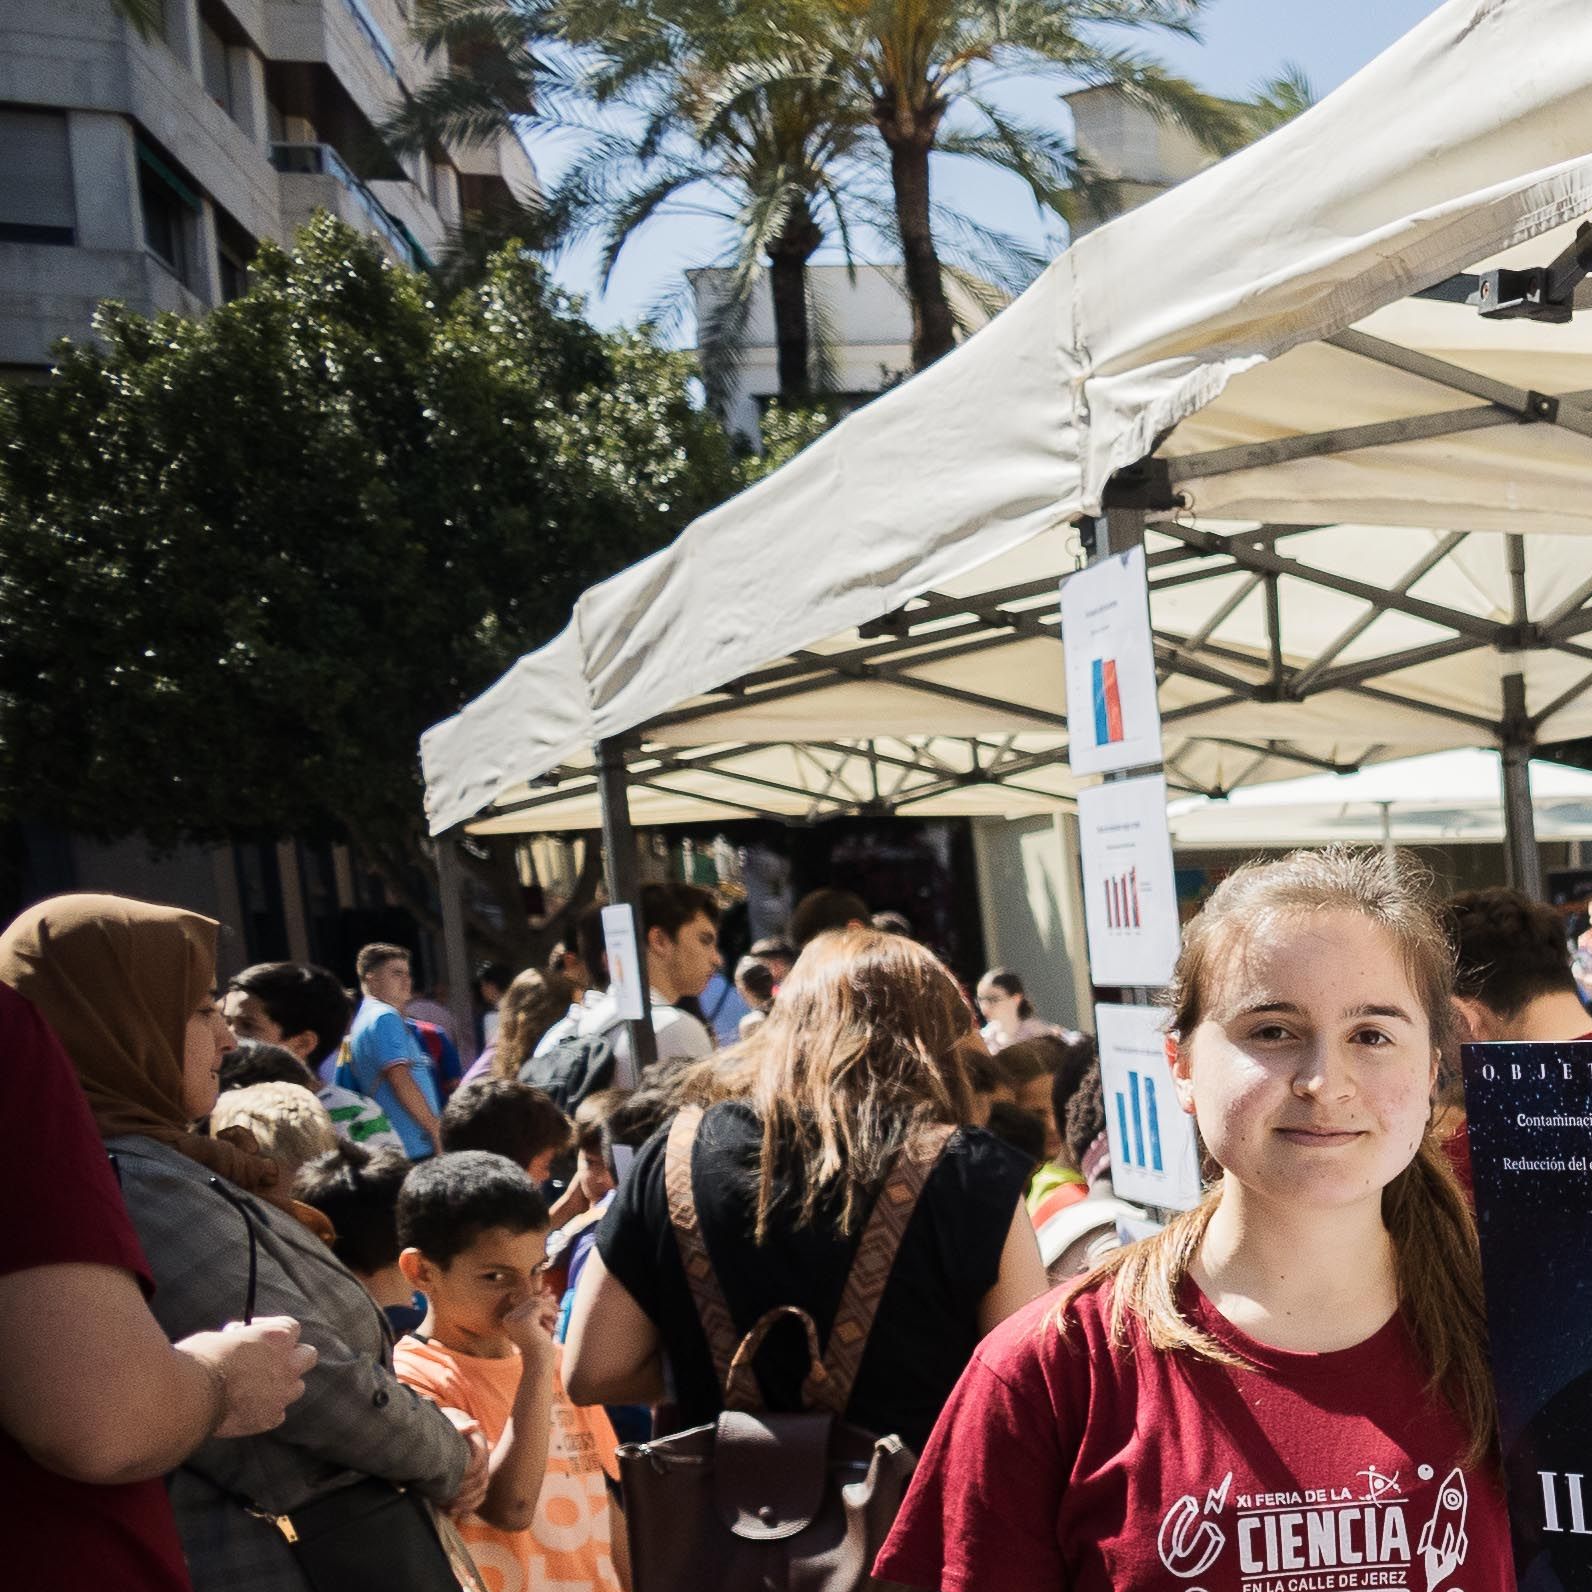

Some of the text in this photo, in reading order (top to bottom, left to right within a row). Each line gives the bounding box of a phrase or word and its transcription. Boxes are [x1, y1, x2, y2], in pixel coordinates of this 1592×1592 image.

[1503, 1158, 1565, 1171] Reducción
[1568, 1156, 1587, 1171] del
[1236, 1487, 1353, 1508] XI FERIA DE LA
[1237, 1506, 1412, 1574] CIENCIA
[1288, 1575, 1335, 1592] CALLE
[1338, 1573, 1359, 1588] DE
[1361, 1571, 1407, 1586] JEREZ
